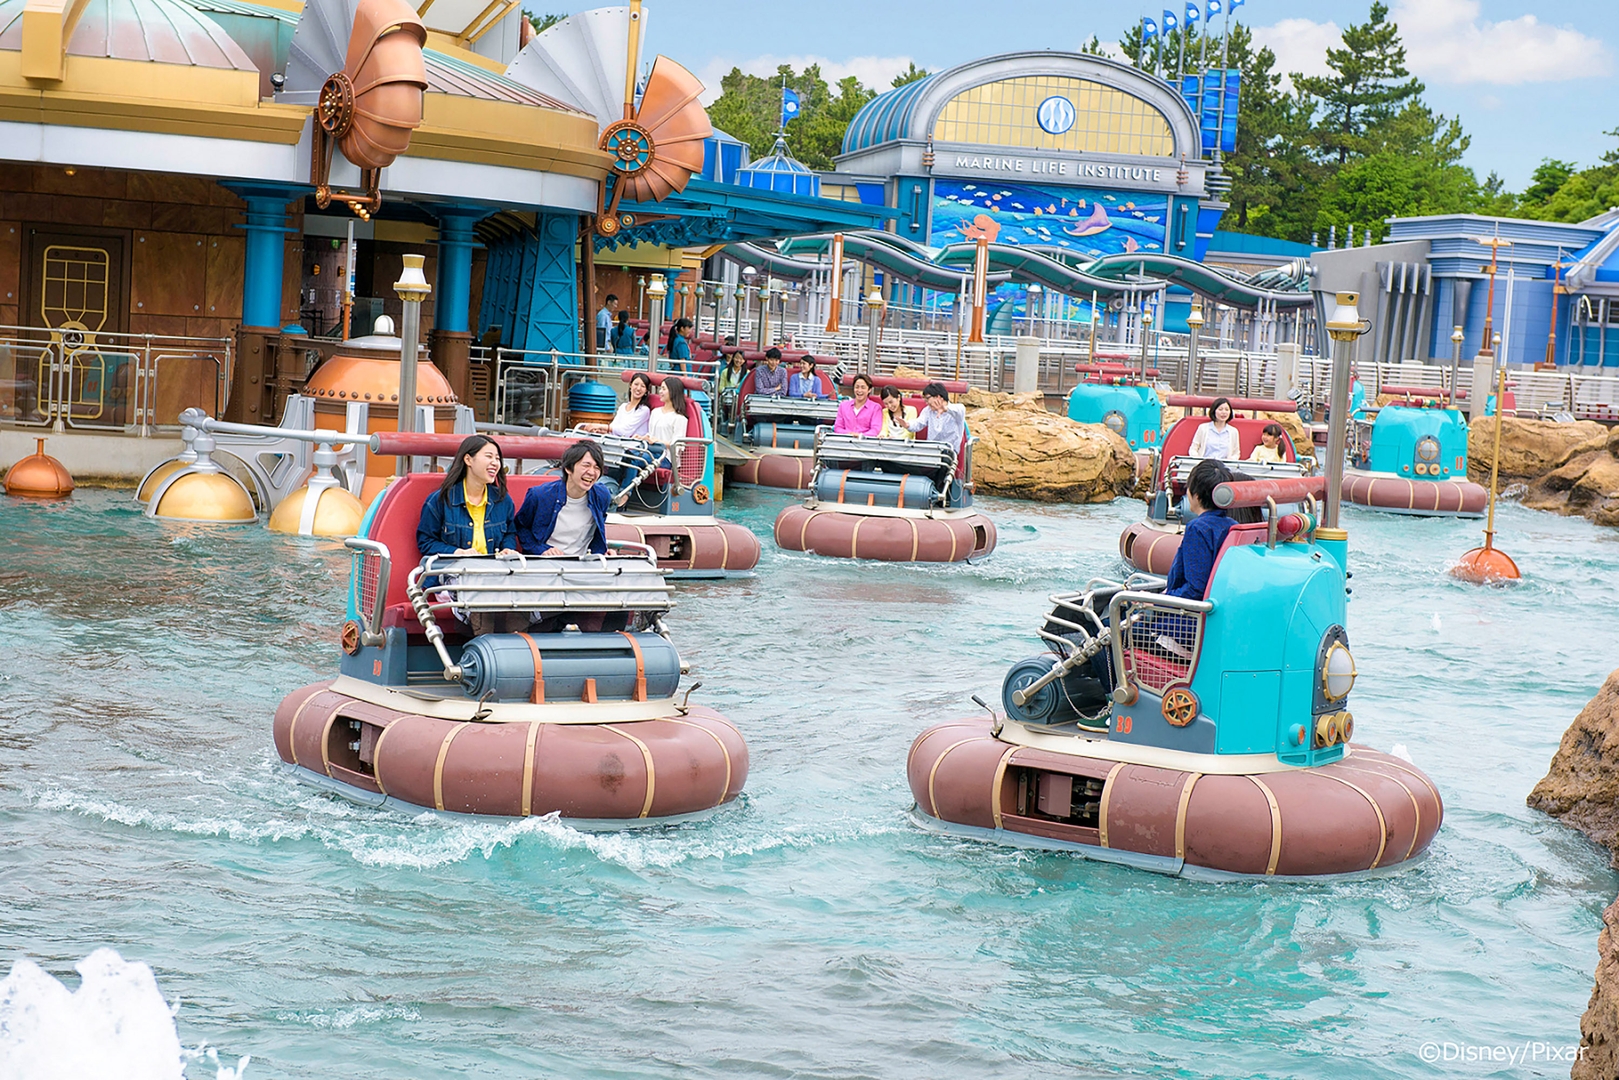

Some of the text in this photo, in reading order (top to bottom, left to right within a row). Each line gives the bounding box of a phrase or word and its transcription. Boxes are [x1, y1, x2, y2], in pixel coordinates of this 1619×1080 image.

[955, 156, 1161, 182] MARINE LIFE INSTITUTE
[1115, 715, 1133, 734] 39
